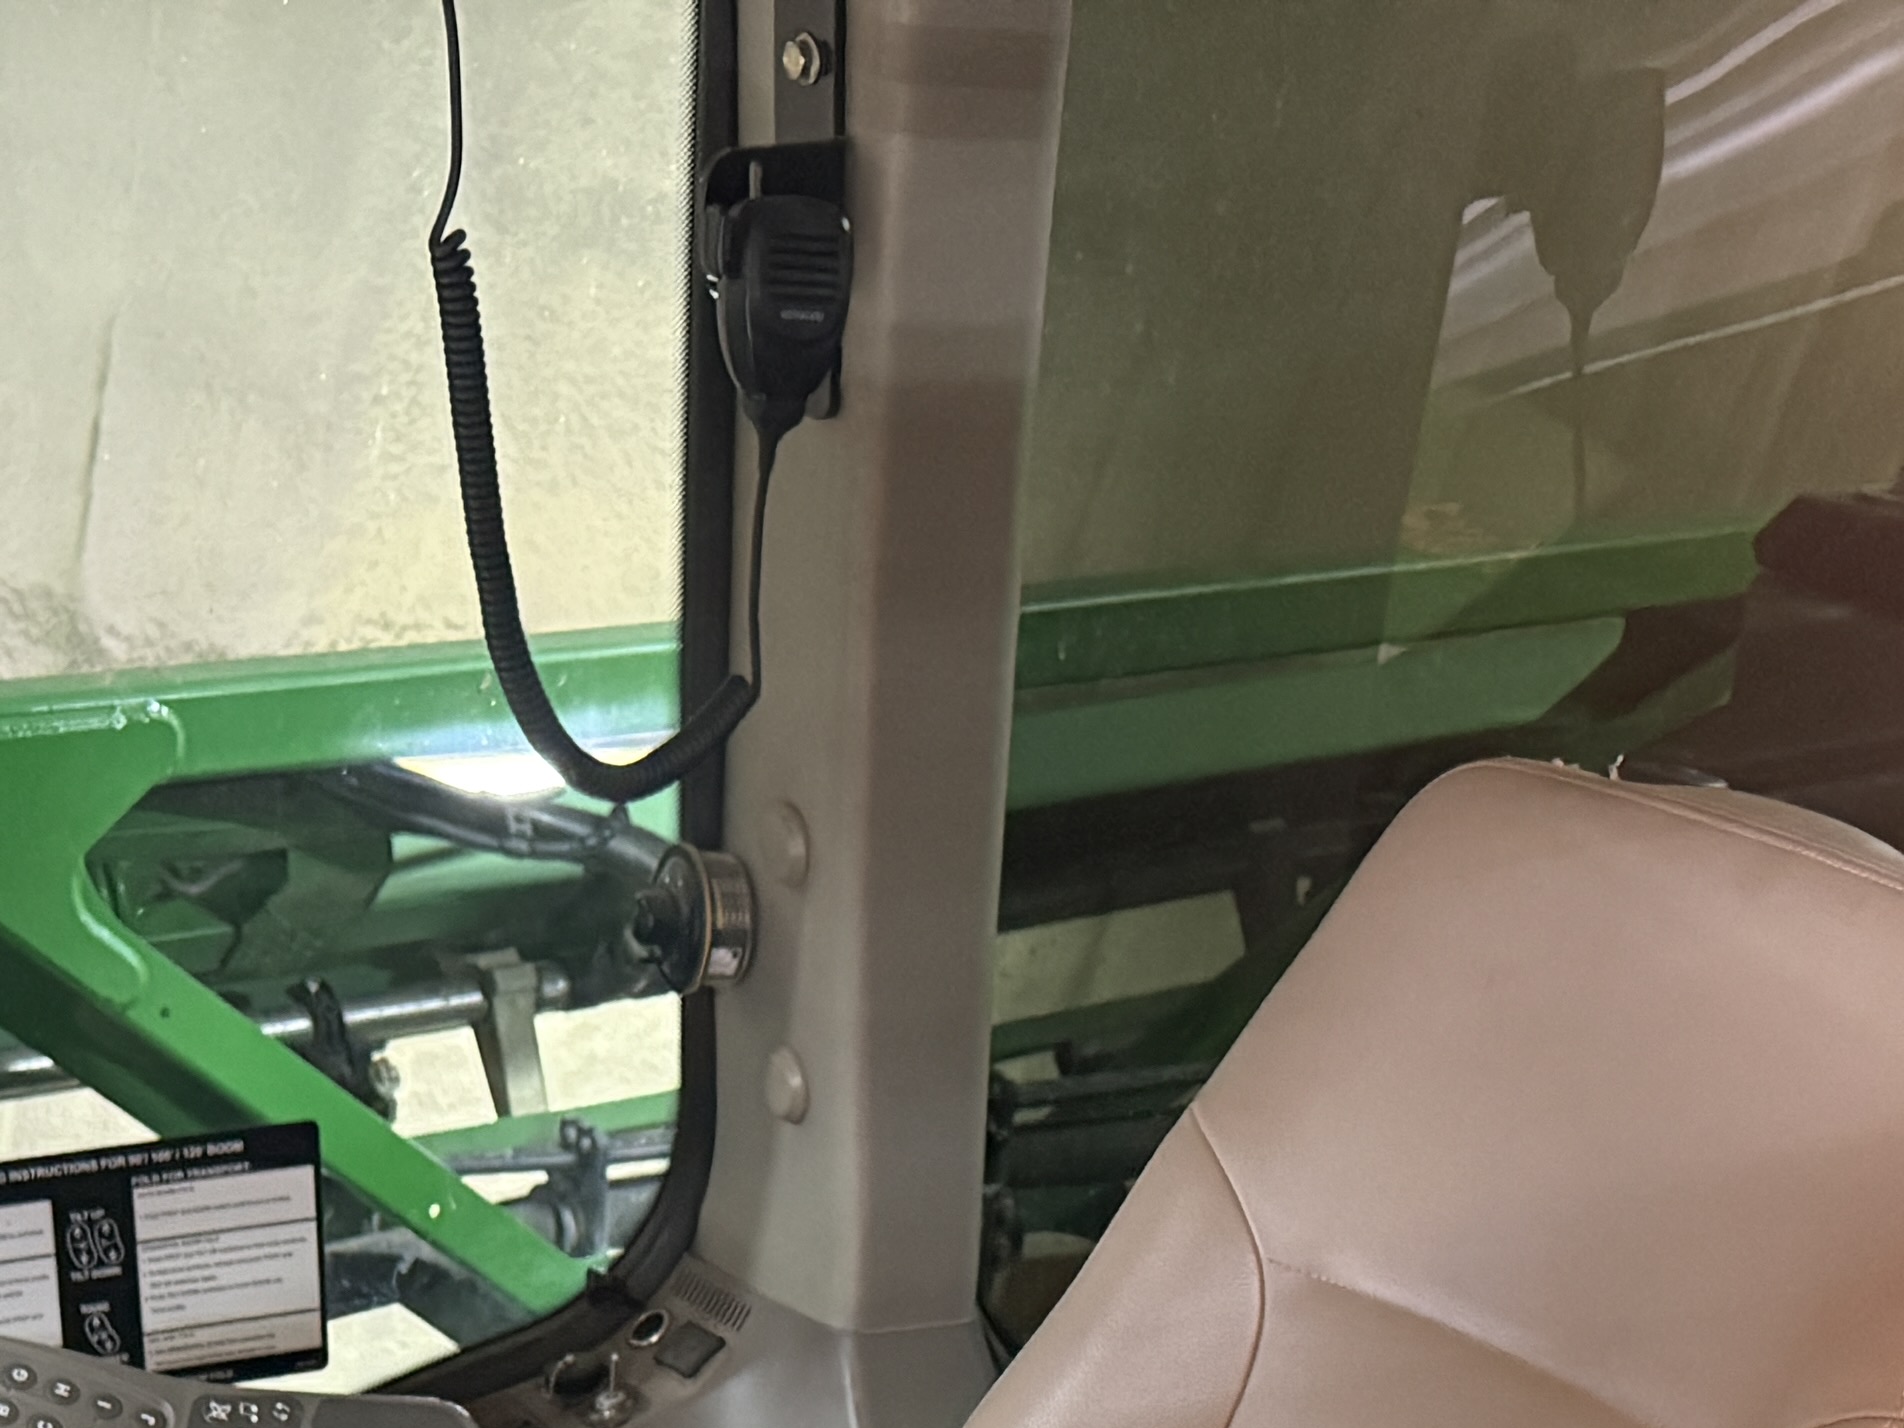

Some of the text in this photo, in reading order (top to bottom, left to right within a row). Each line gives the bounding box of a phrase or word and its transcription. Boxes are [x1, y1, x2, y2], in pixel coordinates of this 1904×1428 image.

[8, 1160, 97, 1180] INSTRUCTIONS
[12, 1368, 28, 1382] G
[54, 1382, 71, 1397] H
